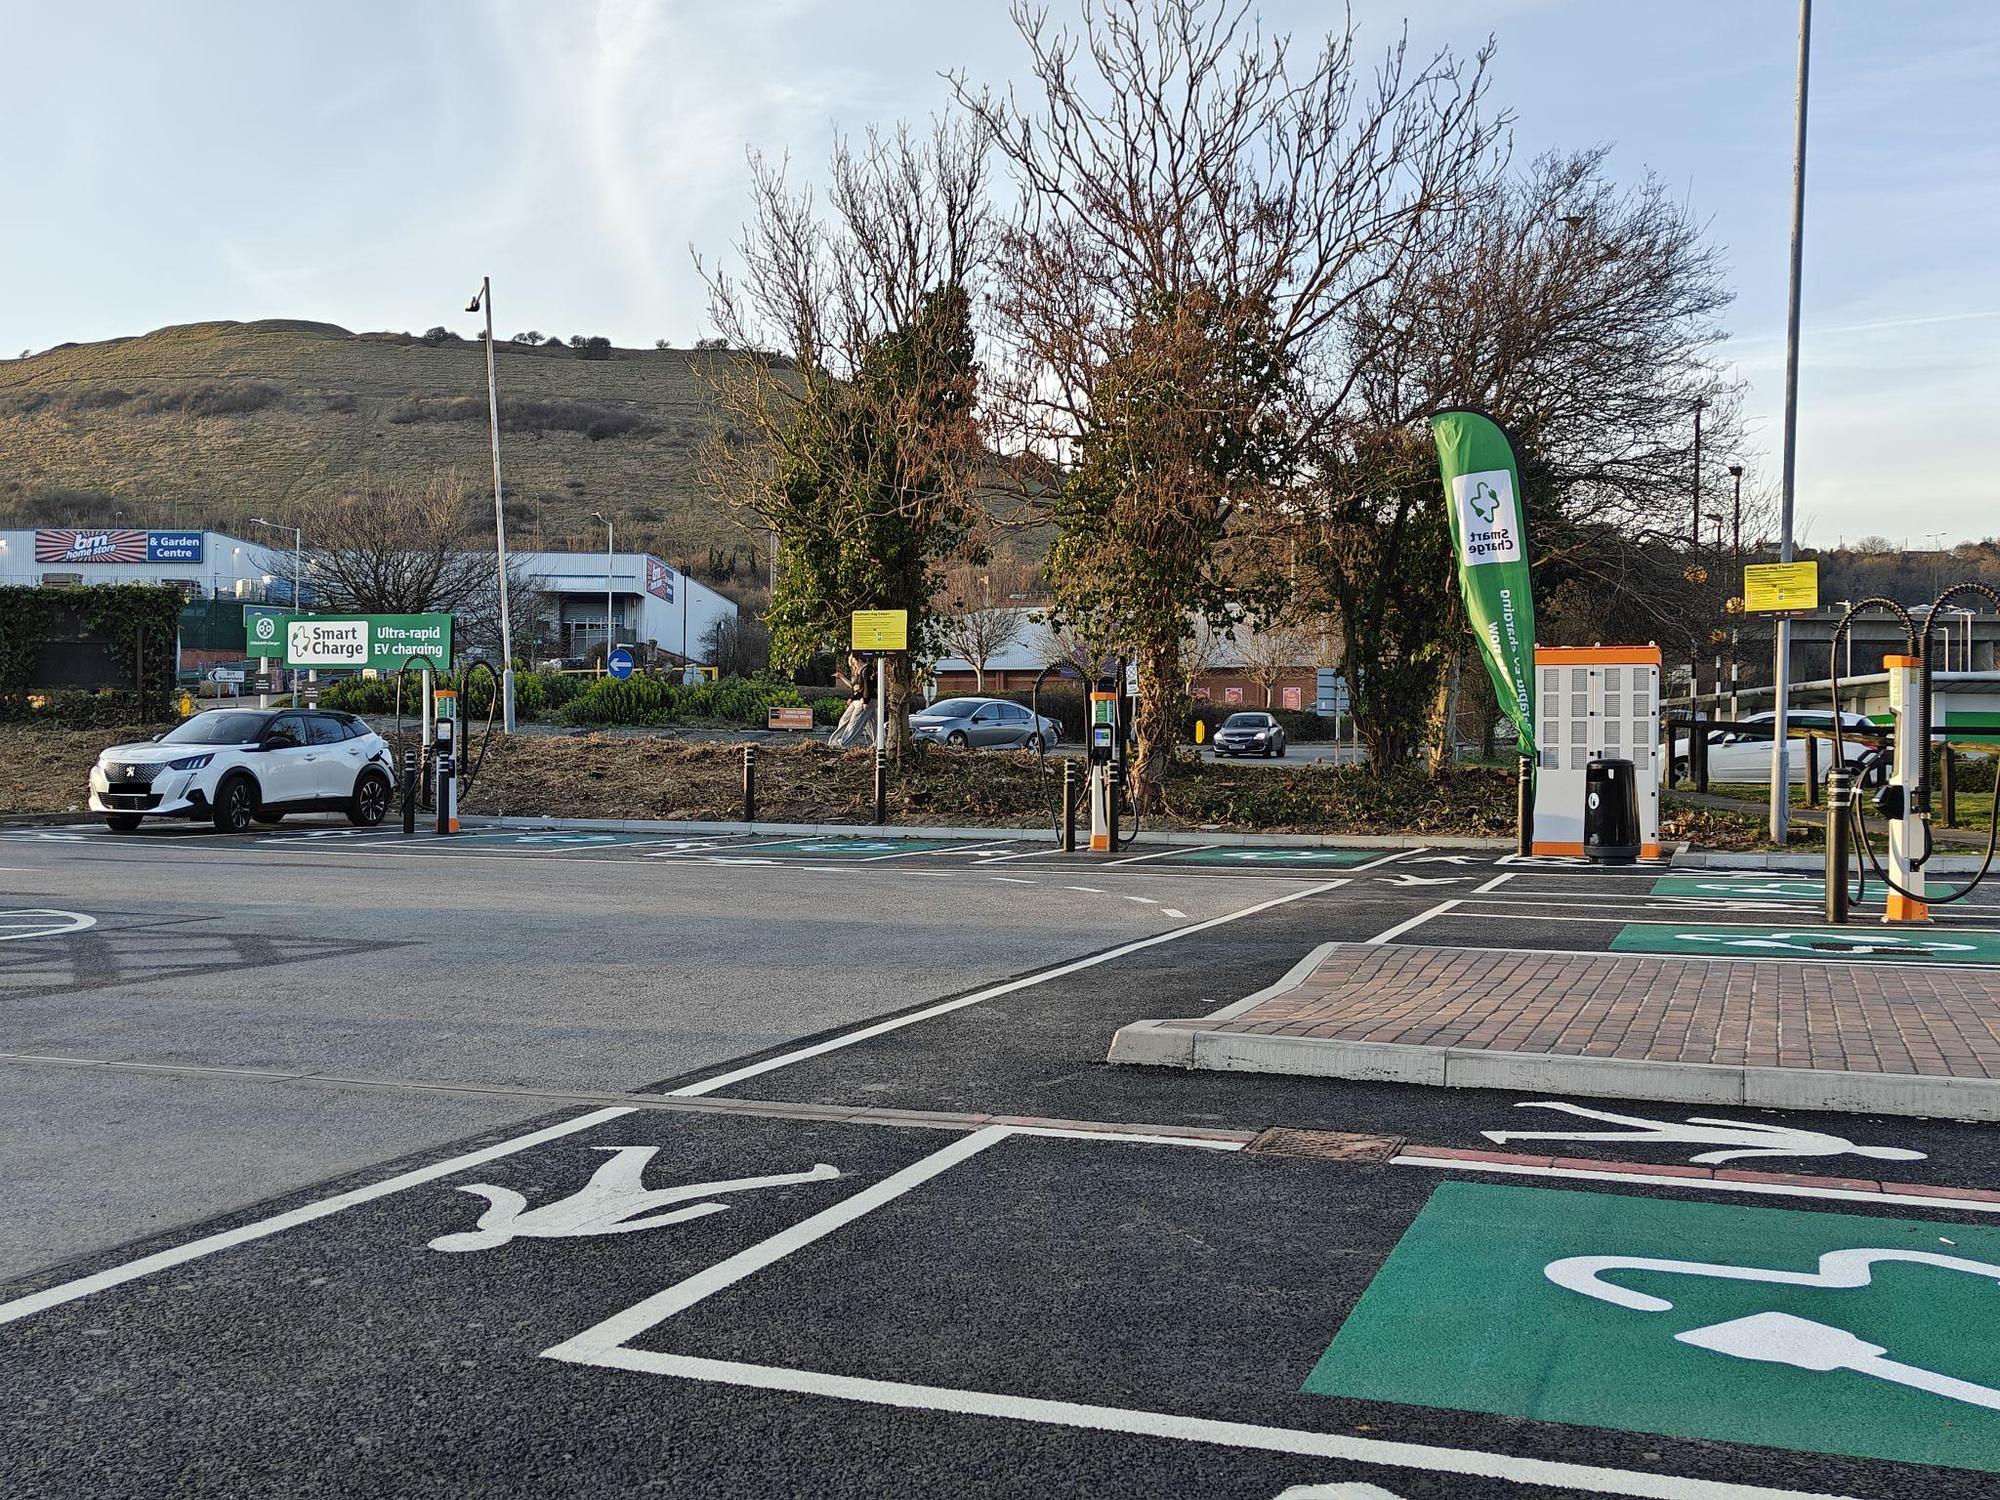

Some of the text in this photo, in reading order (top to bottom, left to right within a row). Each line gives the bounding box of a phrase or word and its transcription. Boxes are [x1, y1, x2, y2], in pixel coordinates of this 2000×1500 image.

[150, 537, 200, 546] & Garden
[66, 544, 117, 559] home store
[156, 548, 192, 558] Centre
[313, 627, 357, 640] Smart
[377, 626, 441, 641] Ultra-rapid
[312, 641, 363, 659] Charge
[374, 643, 443, 657] EV charging
